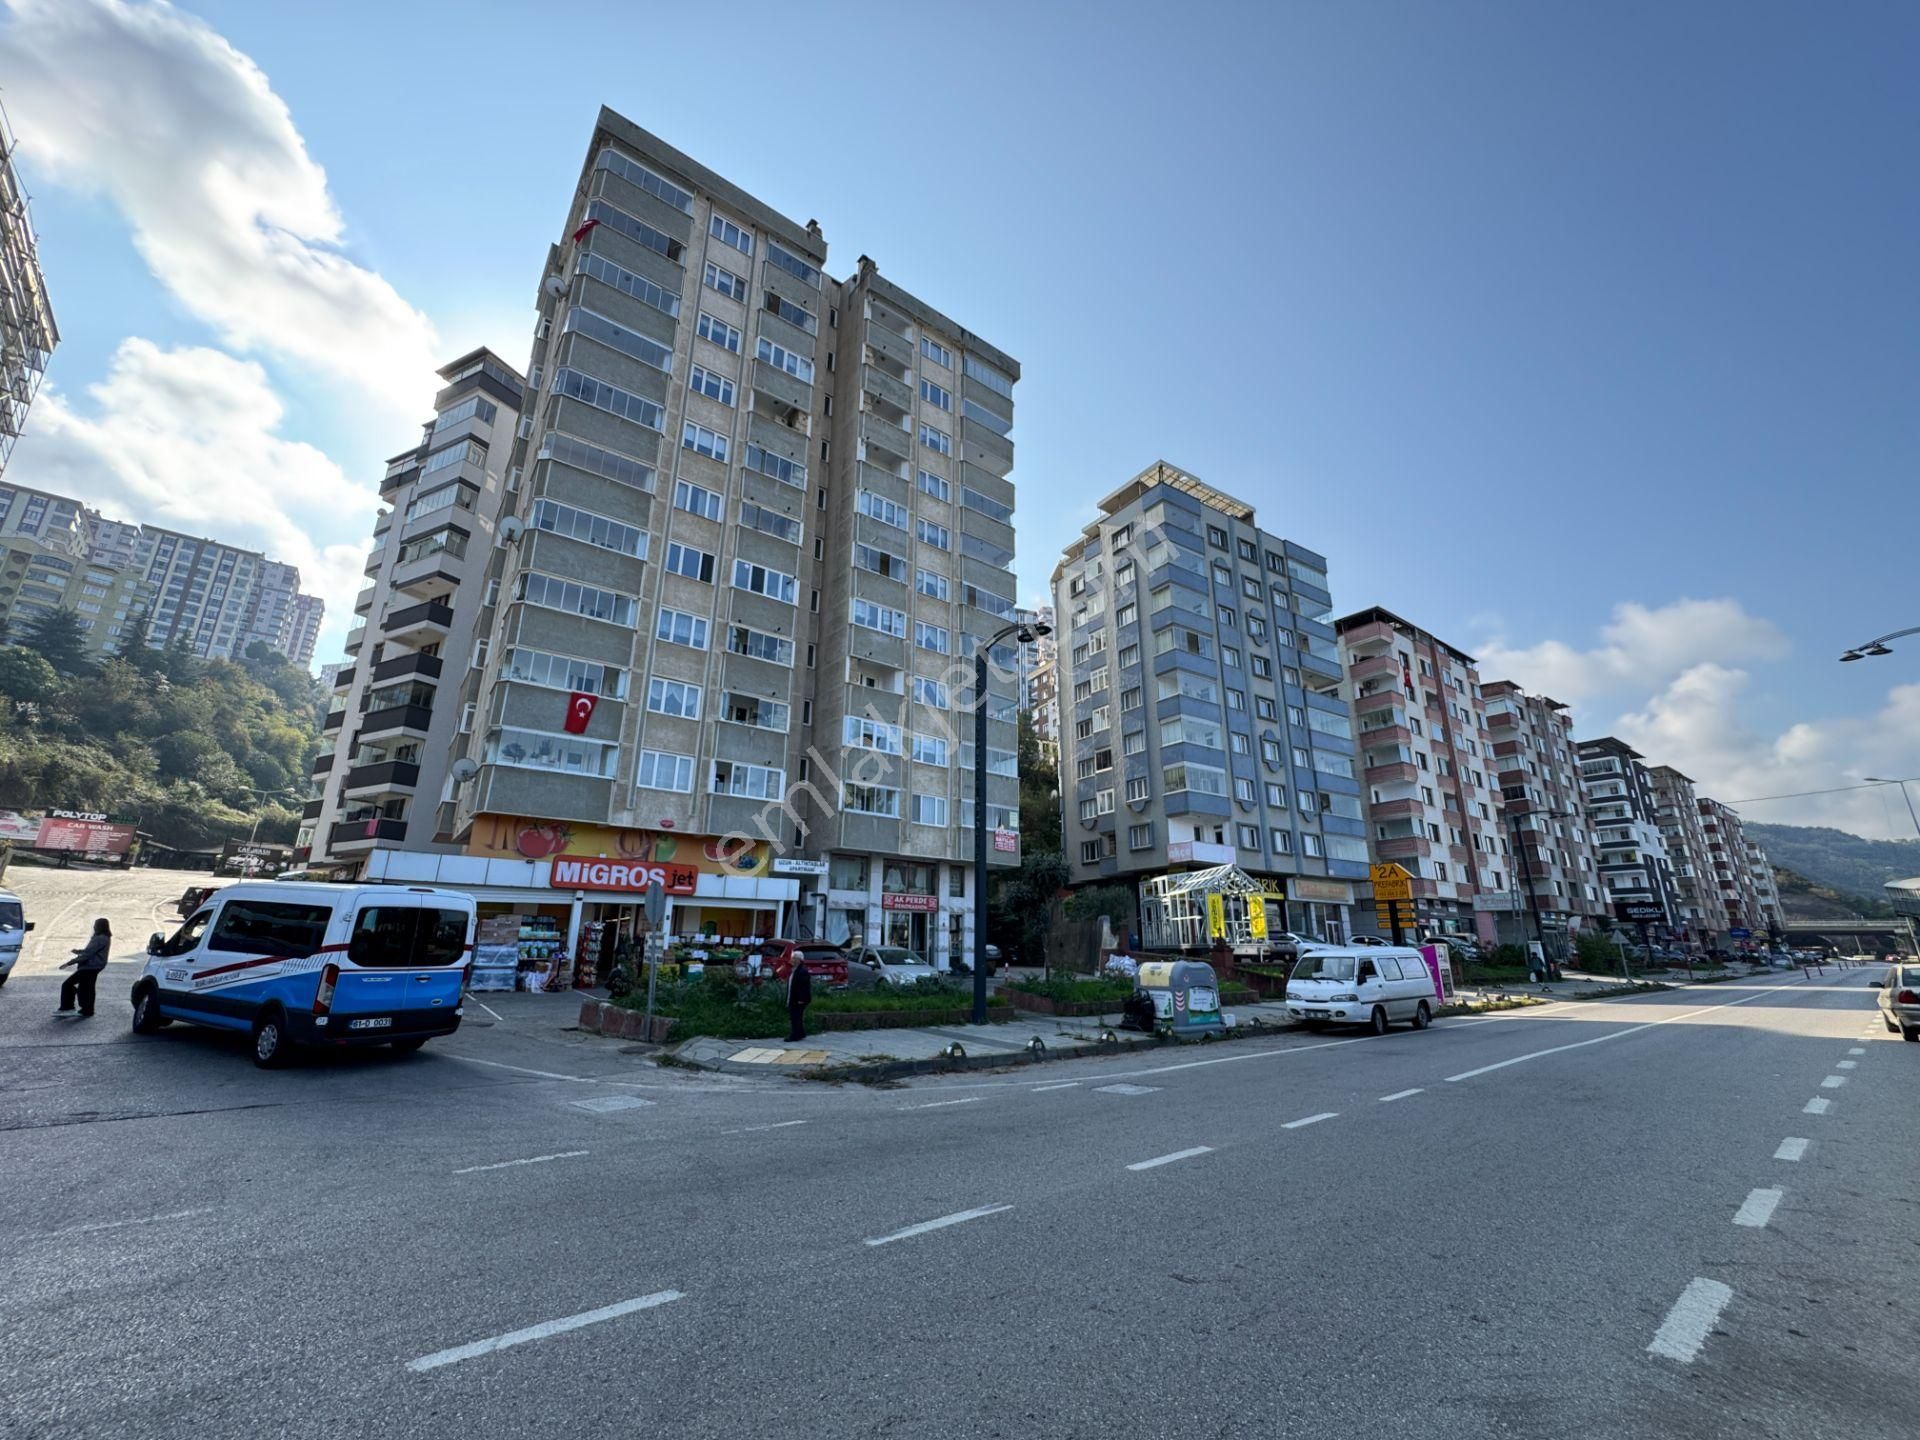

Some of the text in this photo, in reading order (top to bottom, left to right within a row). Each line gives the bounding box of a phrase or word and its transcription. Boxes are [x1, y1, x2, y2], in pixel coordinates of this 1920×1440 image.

[52, 809, 107, 821] POLYTOP
[67, 822, 114, 832] CAR WASH
[667, 869, 694, 888] jet
[1378, 866, 1399, 879] 2A
